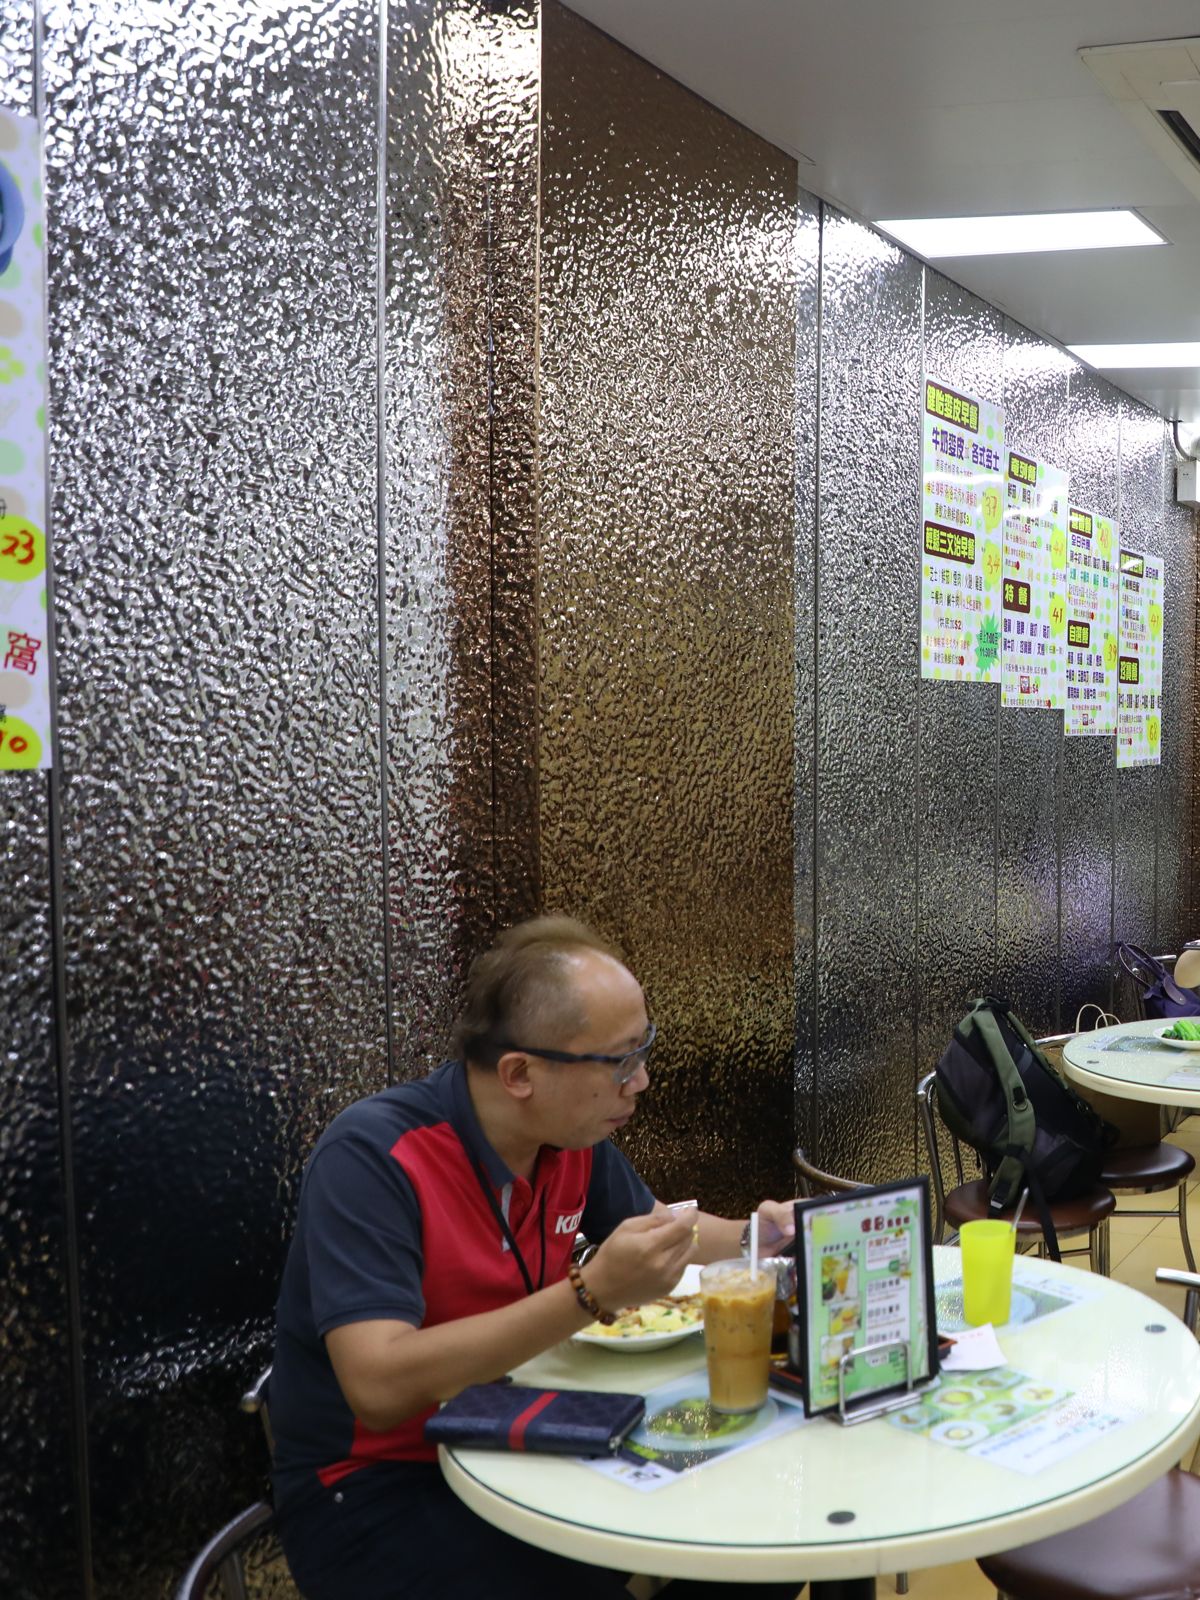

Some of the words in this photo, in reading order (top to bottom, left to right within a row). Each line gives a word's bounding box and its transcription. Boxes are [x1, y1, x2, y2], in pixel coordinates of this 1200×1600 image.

[926, 384, 978, 430] 健怡麥皮早餐
[932, 427, 964, 460] 牛奶麥皮
[971, 442, 1000, 472] 各式多士
[2, 529, 36, 566] 23
[925, 527, 975, 561] 輕鬆三文治早餐
[1053, 607, 1063, 623] 41
[4, 631, 42, 676] 窩
